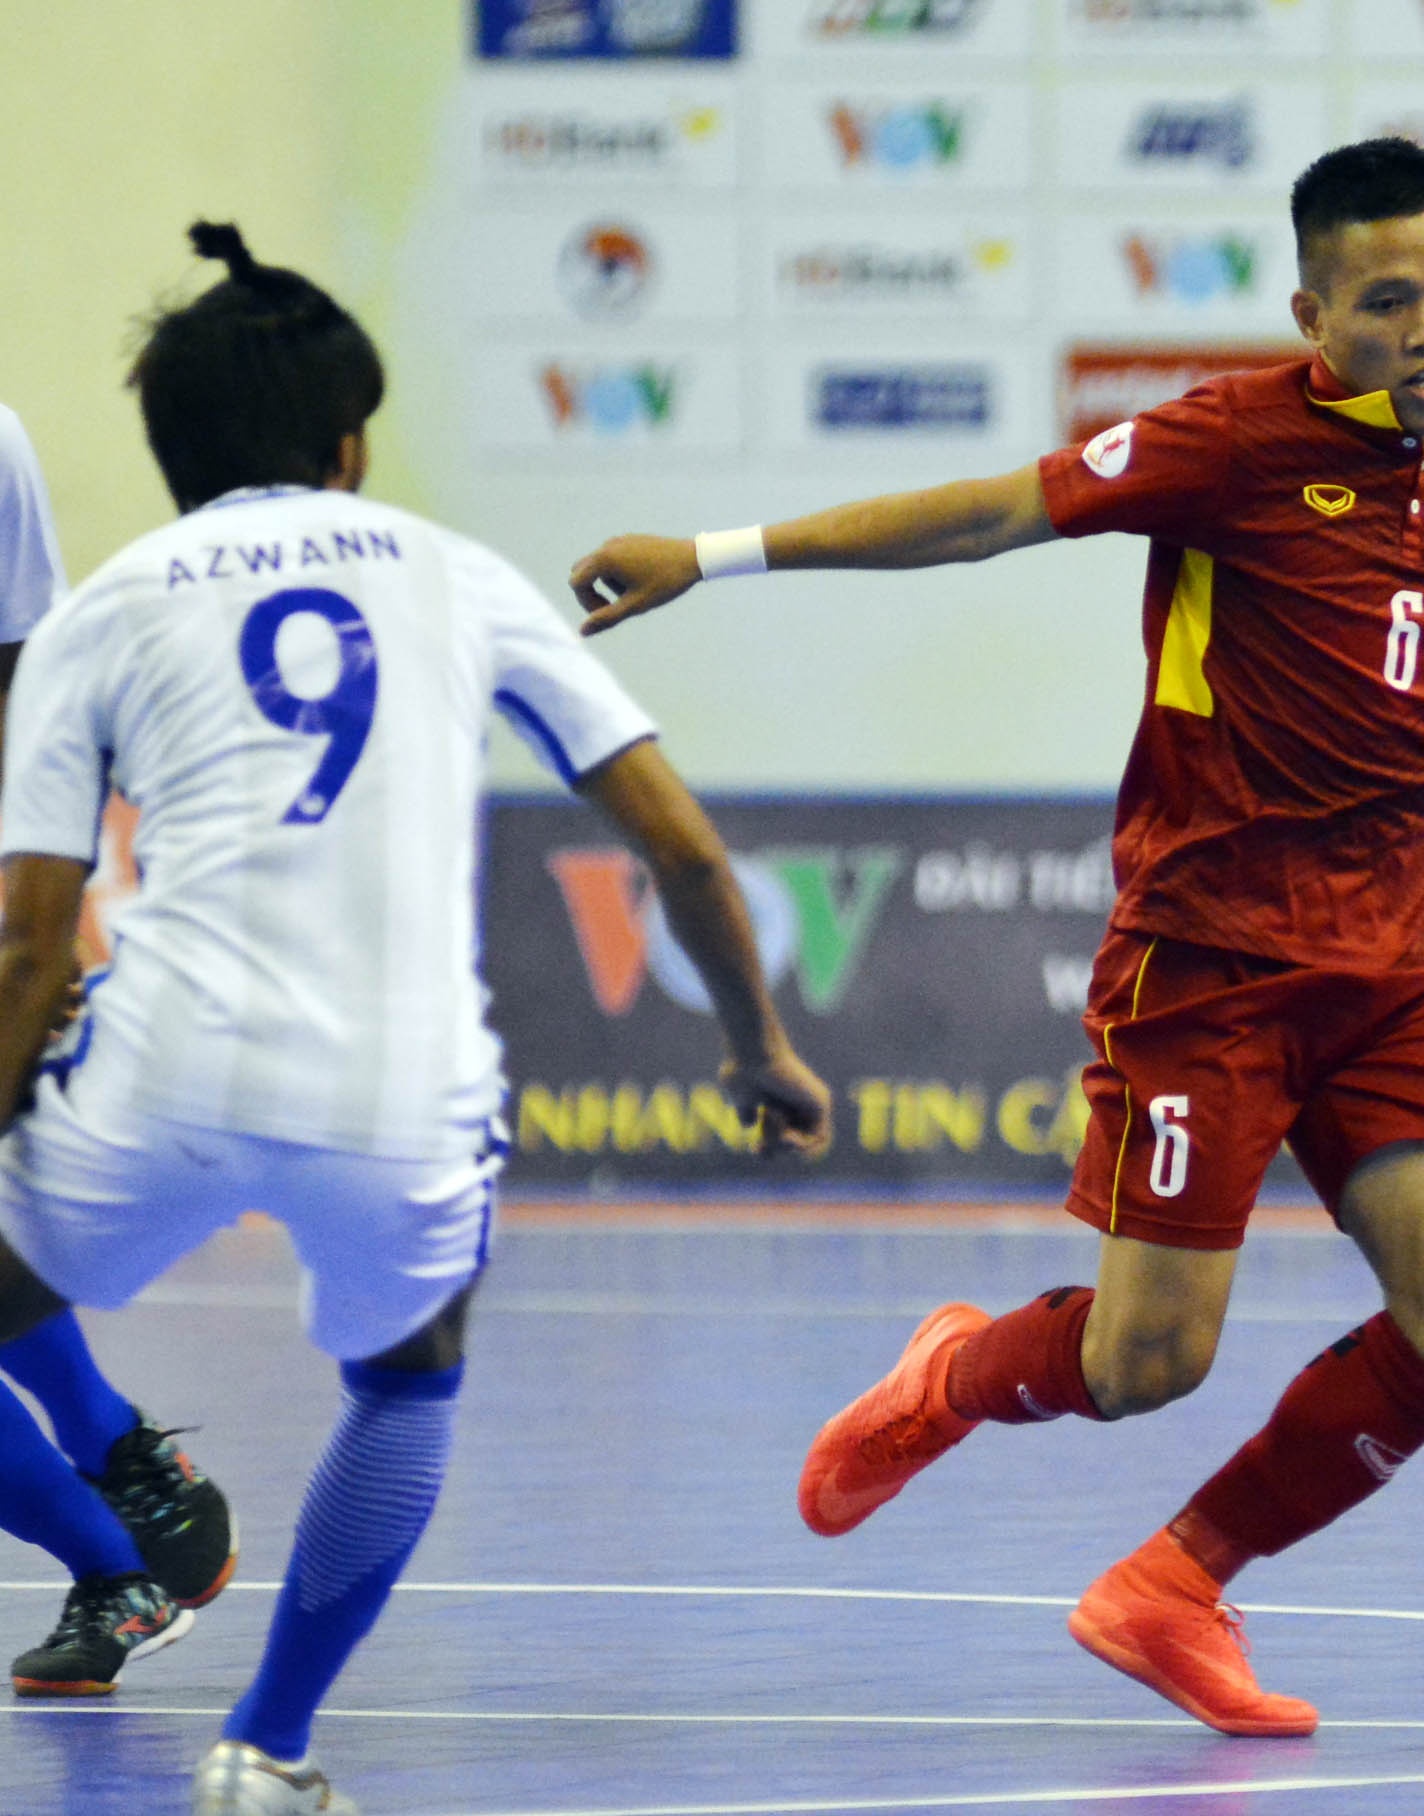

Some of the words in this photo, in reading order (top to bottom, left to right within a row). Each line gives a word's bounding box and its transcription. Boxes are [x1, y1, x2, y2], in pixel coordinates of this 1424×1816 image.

[166, 528, 404, 590] AZWANN
[1384, 590, 1424, 691] 6
[238, 586, 380, 826] 9
[855, 1080, 982, 1153] TIN
[1149, 1094, 1190, 1198] 6
